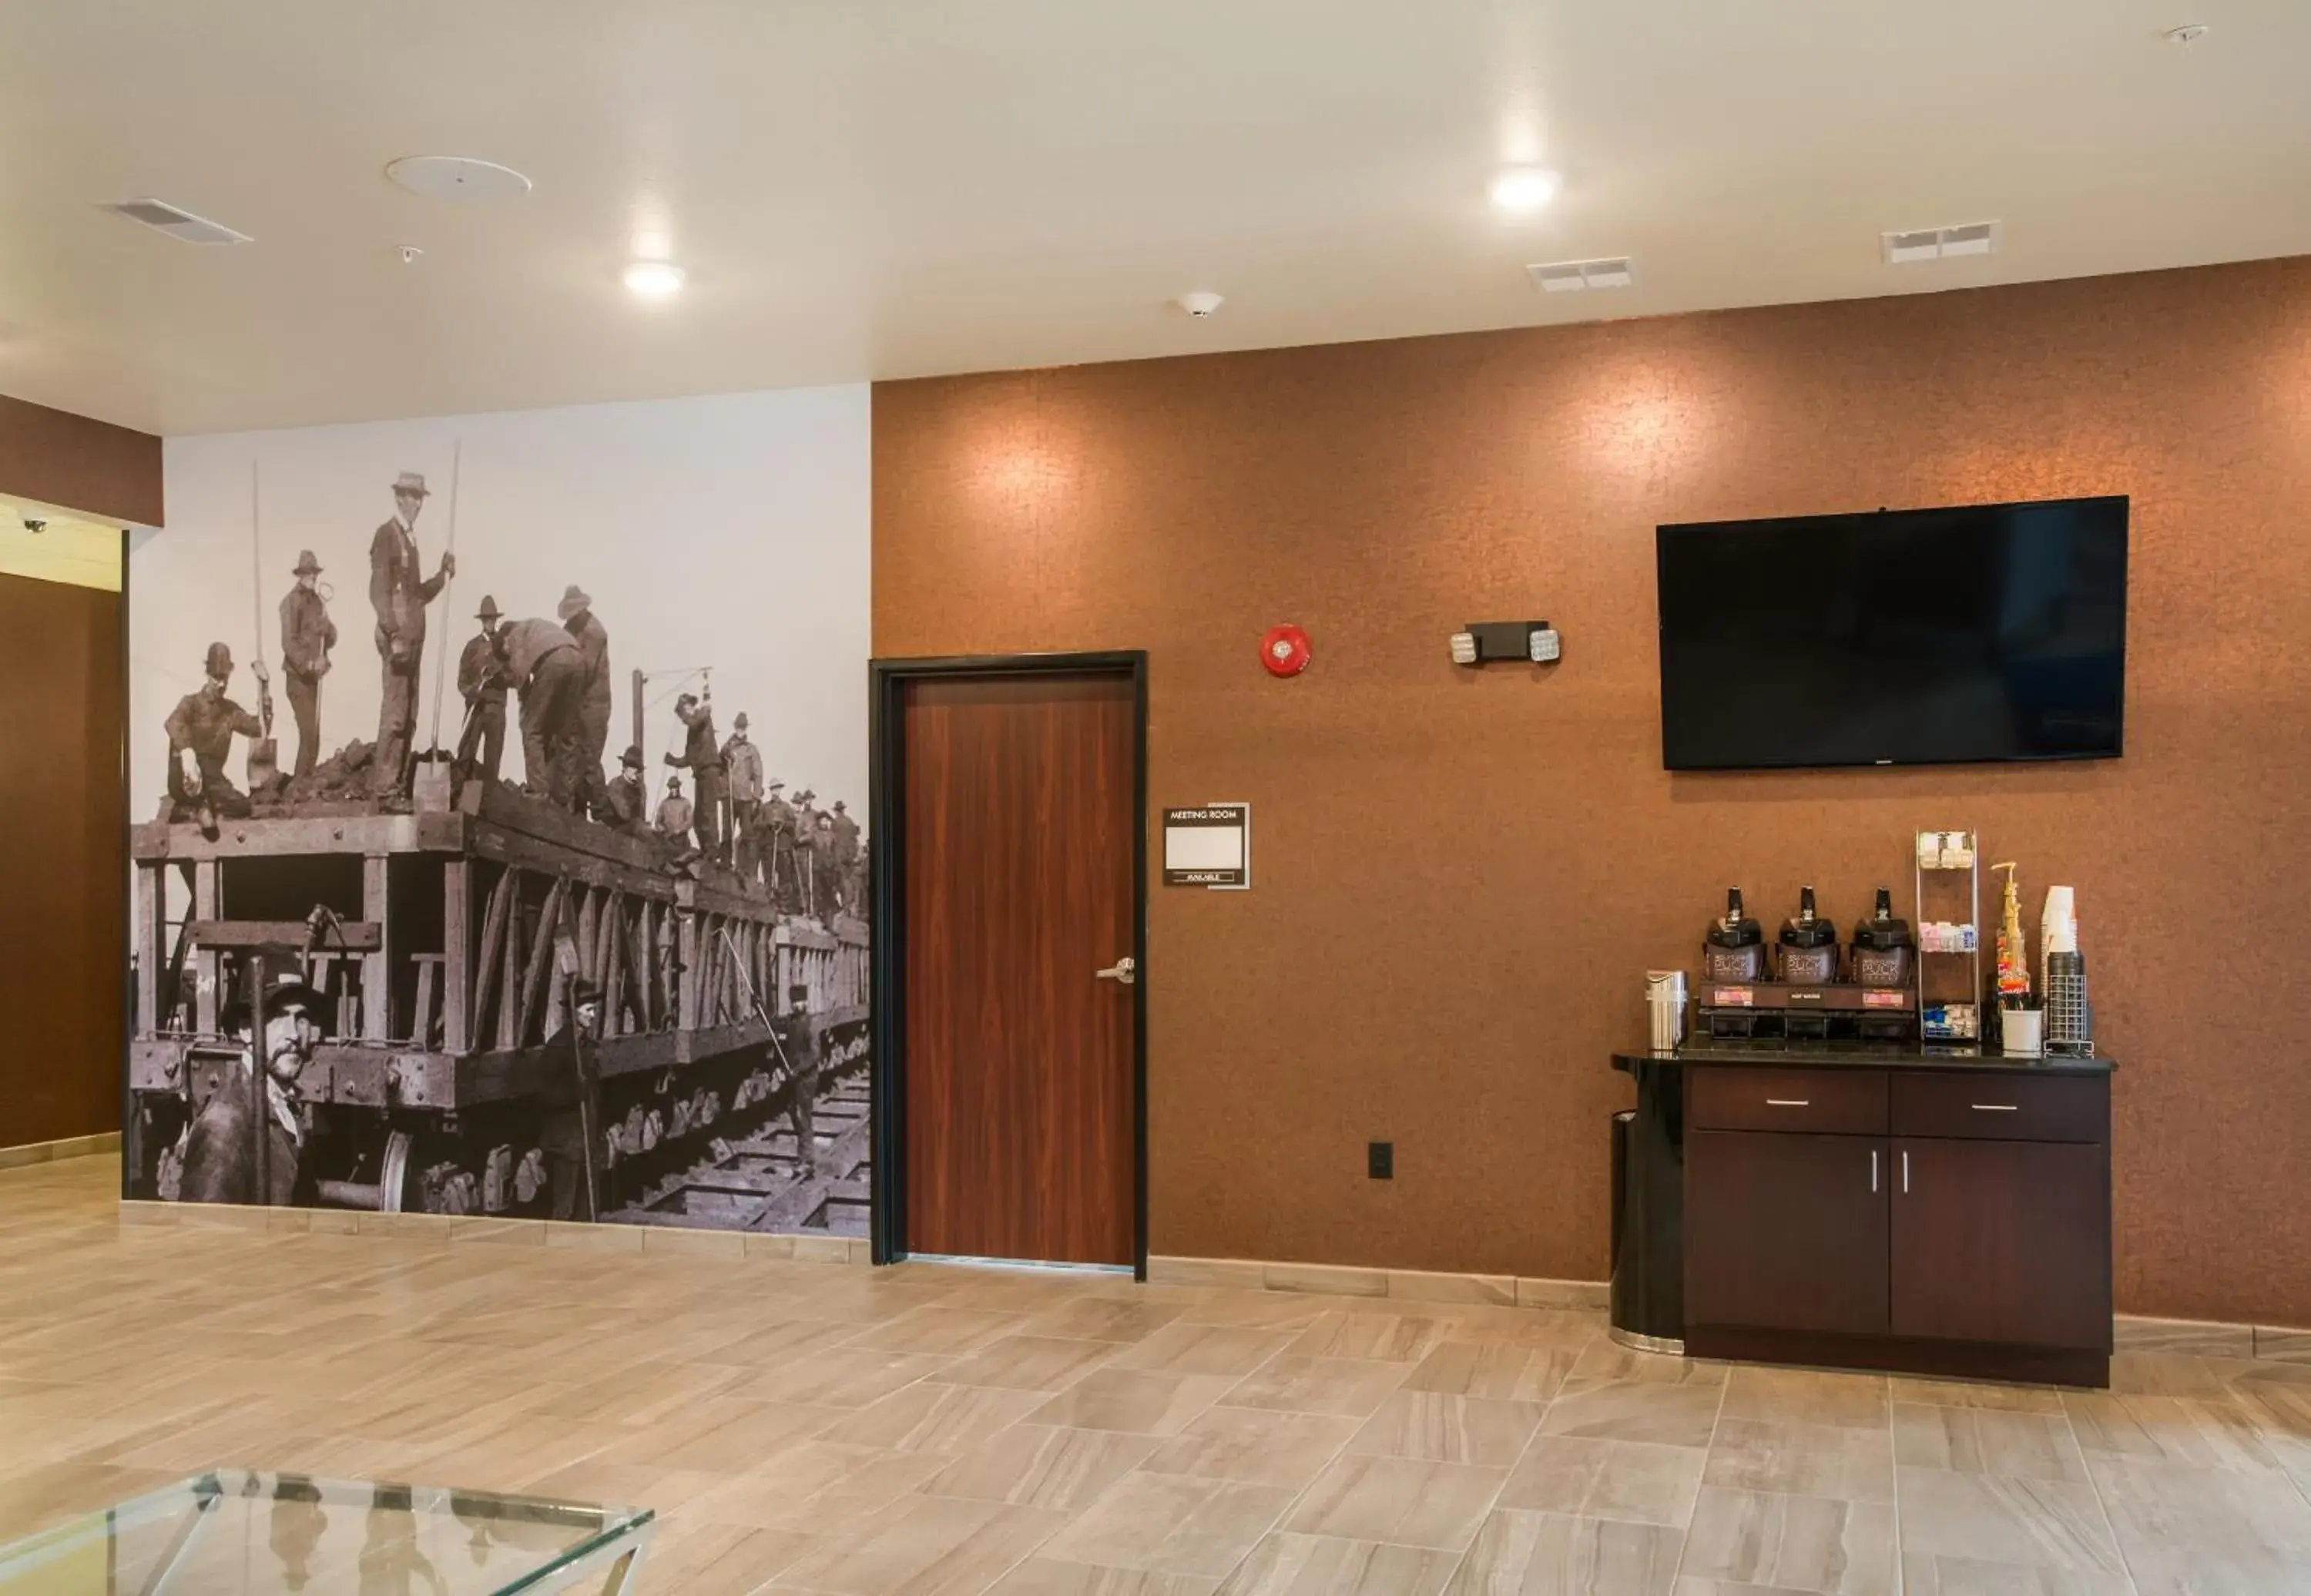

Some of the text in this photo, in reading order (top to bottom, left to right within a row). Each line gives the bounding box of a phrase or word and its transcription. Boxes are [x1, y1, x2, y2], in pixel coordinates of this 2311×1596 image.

[1170, 810, 1236, 819] MEETING ROOM
[1714, 960, 1748, 971] PUCK
[1787, 960, 1822, 971] PUCK
[1862, 964, 1899, 974] PUCK
